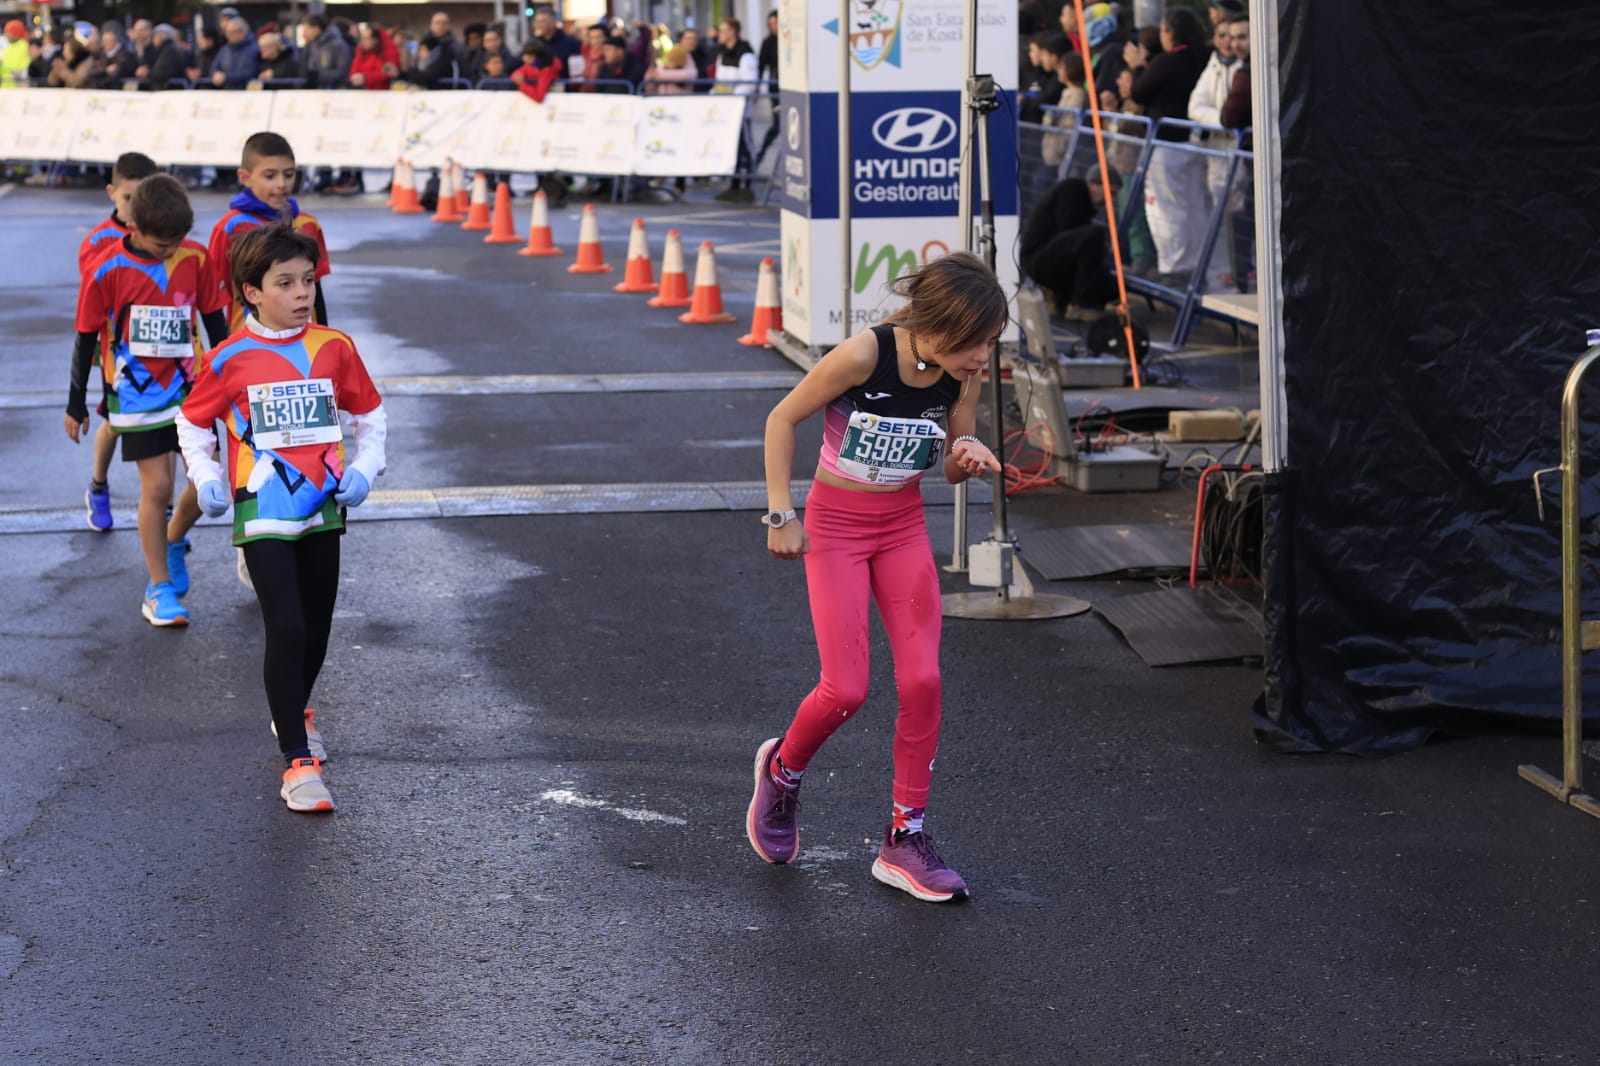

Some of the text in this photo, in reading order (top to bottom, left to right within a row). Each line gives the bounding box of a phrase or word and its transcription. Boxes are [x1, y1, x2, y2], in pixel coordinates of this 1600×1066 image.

[907, 13, 932, 26] San
[907, 28, 923, 41] de
[854, 158, 960, 179] HYUNDA
[854, 181, 960, 202] Gestoraut
[150, 308, 186, 318] SETEL
[138, 319, 181, 340] 5943
[272, 383, 326, 397] SETEL
[262, 396, 319, 427] 6302
[877, 421, 937, 436] SETEL
[855, 431, 922, 464] 5982
[854, 455, 879, 467] OLIVIA
